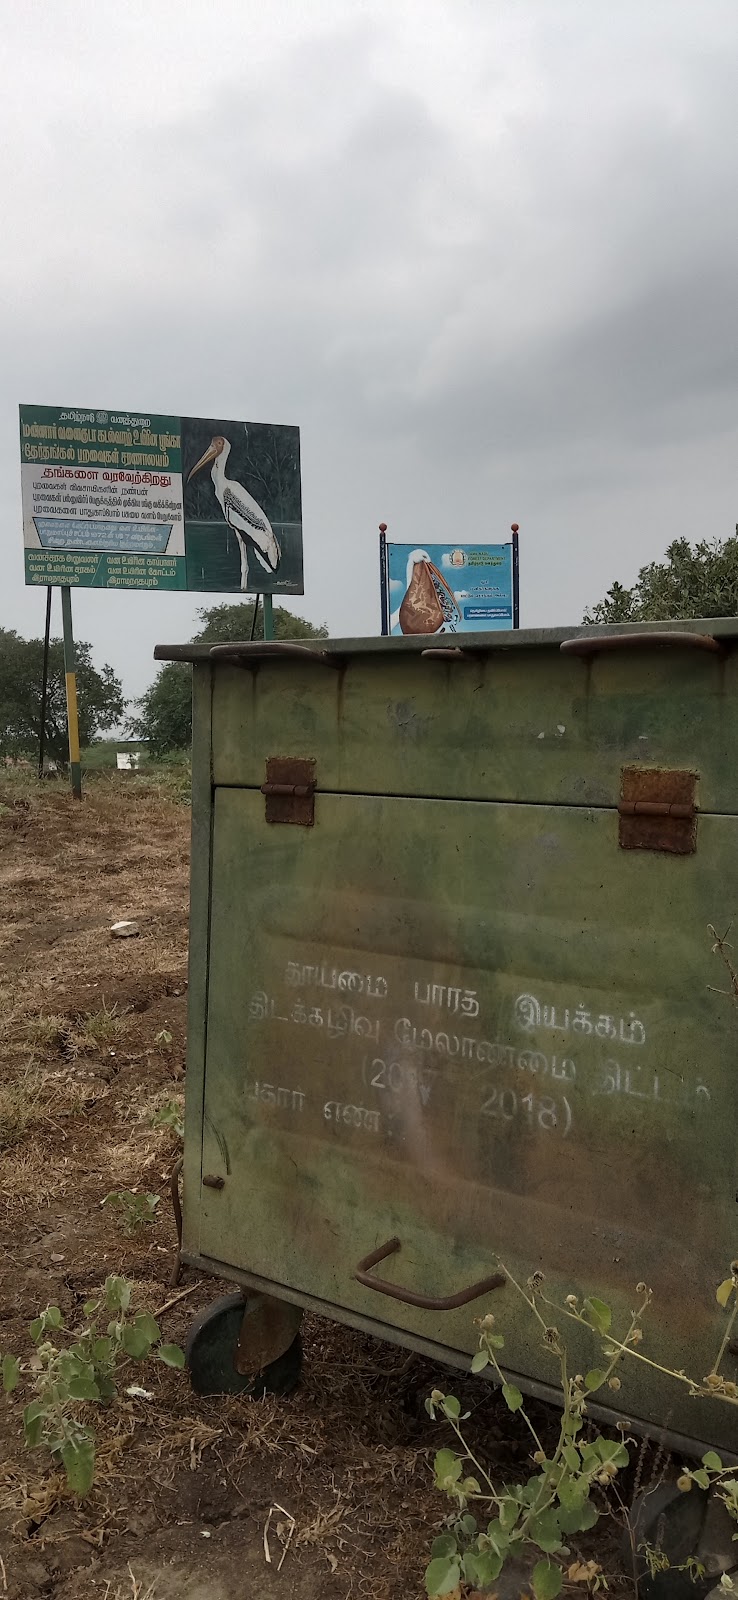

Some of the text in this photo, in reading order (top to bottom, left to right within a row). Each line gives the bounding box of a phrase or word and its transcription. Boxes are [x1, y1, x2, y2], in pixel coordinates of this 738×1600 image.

[59, 411, 151, 428] தமிழ்நாடு வனத்துறை
[22, 421, 57, 439] மன்னார்
[77, 448, 119, 463] பறவைகள்
[121, 452, 170, 467] சரணாலயம்
[41, 467, 172, 487] தங்களை வரவேற்கிறது
[32, 481, 149, 496] பறவைகள் விவசாயிகளின் நண்பன்
[32, 493, 62, 502] பறவைகள்
[33, 506, 77, 515] பறவைகளை
[29, 564, 45, 572] வன
[414, 981, 482, 1018] பாரத
[513, 992, 647, 1046] இயக்கம்
